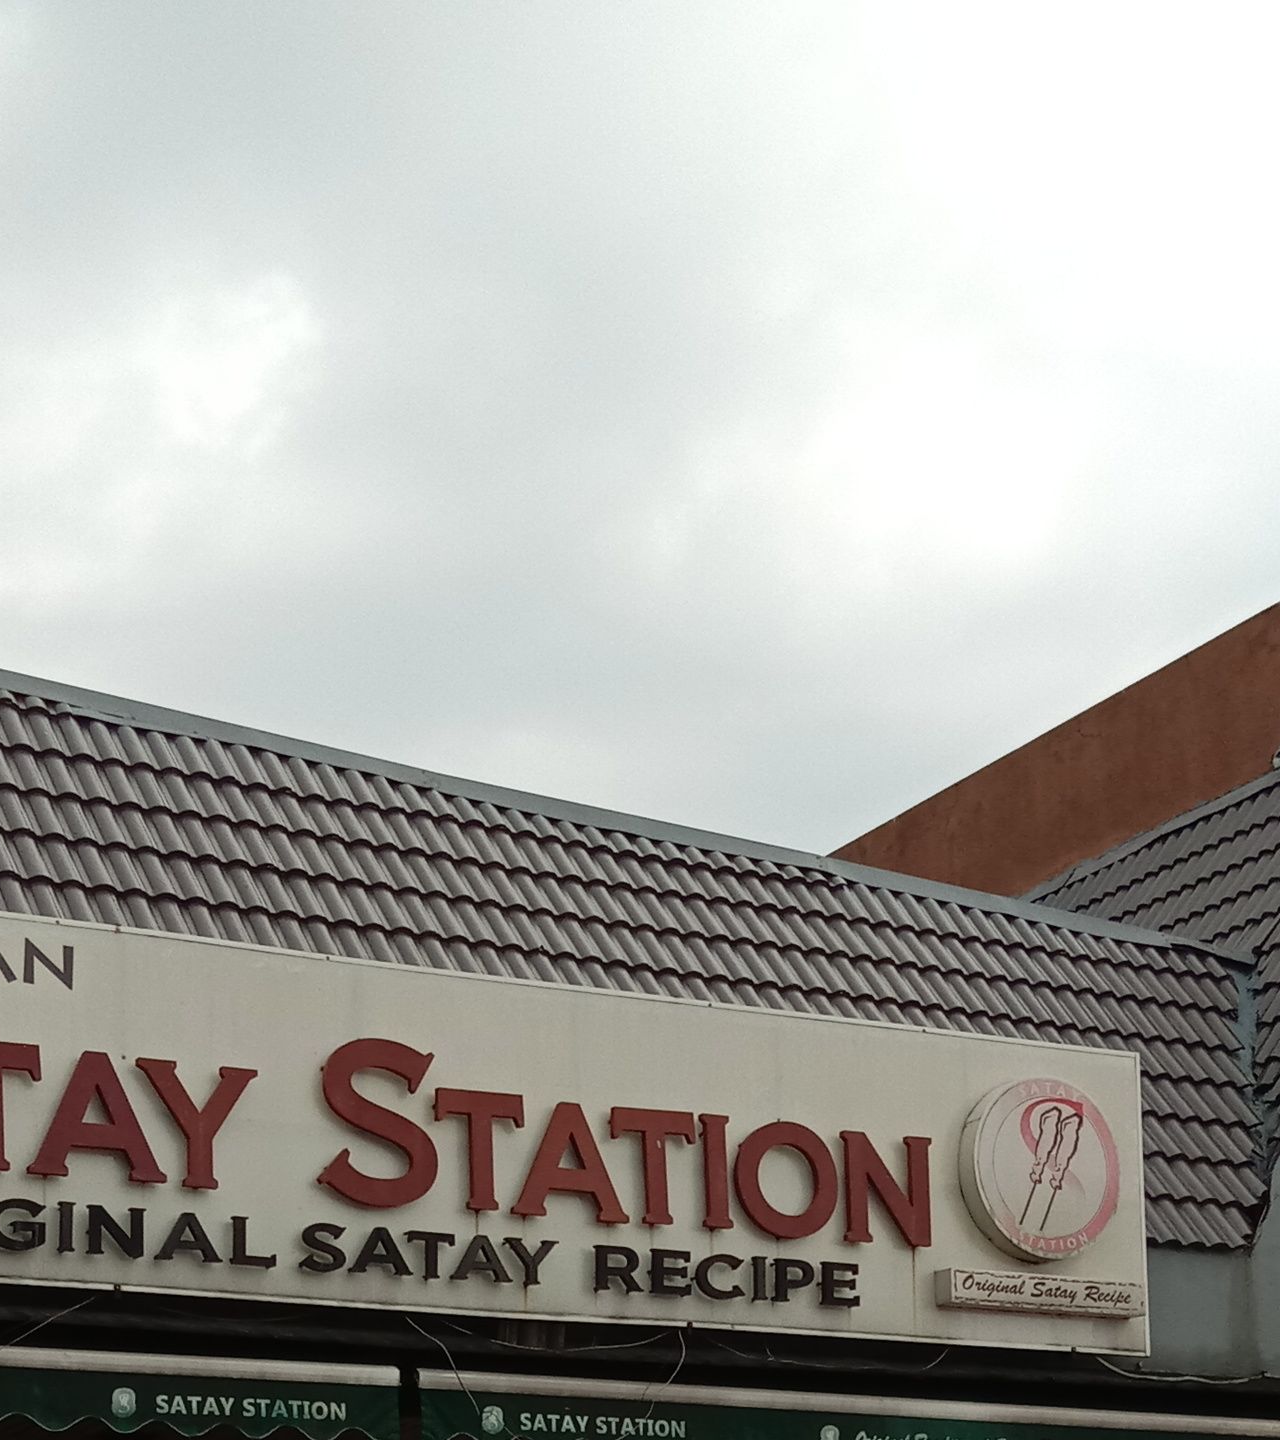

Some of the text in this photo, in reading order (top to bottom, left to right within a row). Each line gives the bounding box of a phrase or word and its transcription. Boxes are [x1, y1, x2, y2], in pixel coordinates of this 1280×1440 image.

[318, 1038, 932, 1248] STATION
[300, 1222, 558, 1289] SATAY
[592, 1244, 861, 1309] RECIPE
[962, 1275, 1132, 1308] Original Satay Recipe
[156, 1394, 347, 1422] SATAY STATION
[519, 1412, 687, 1439] SATAY STATION
